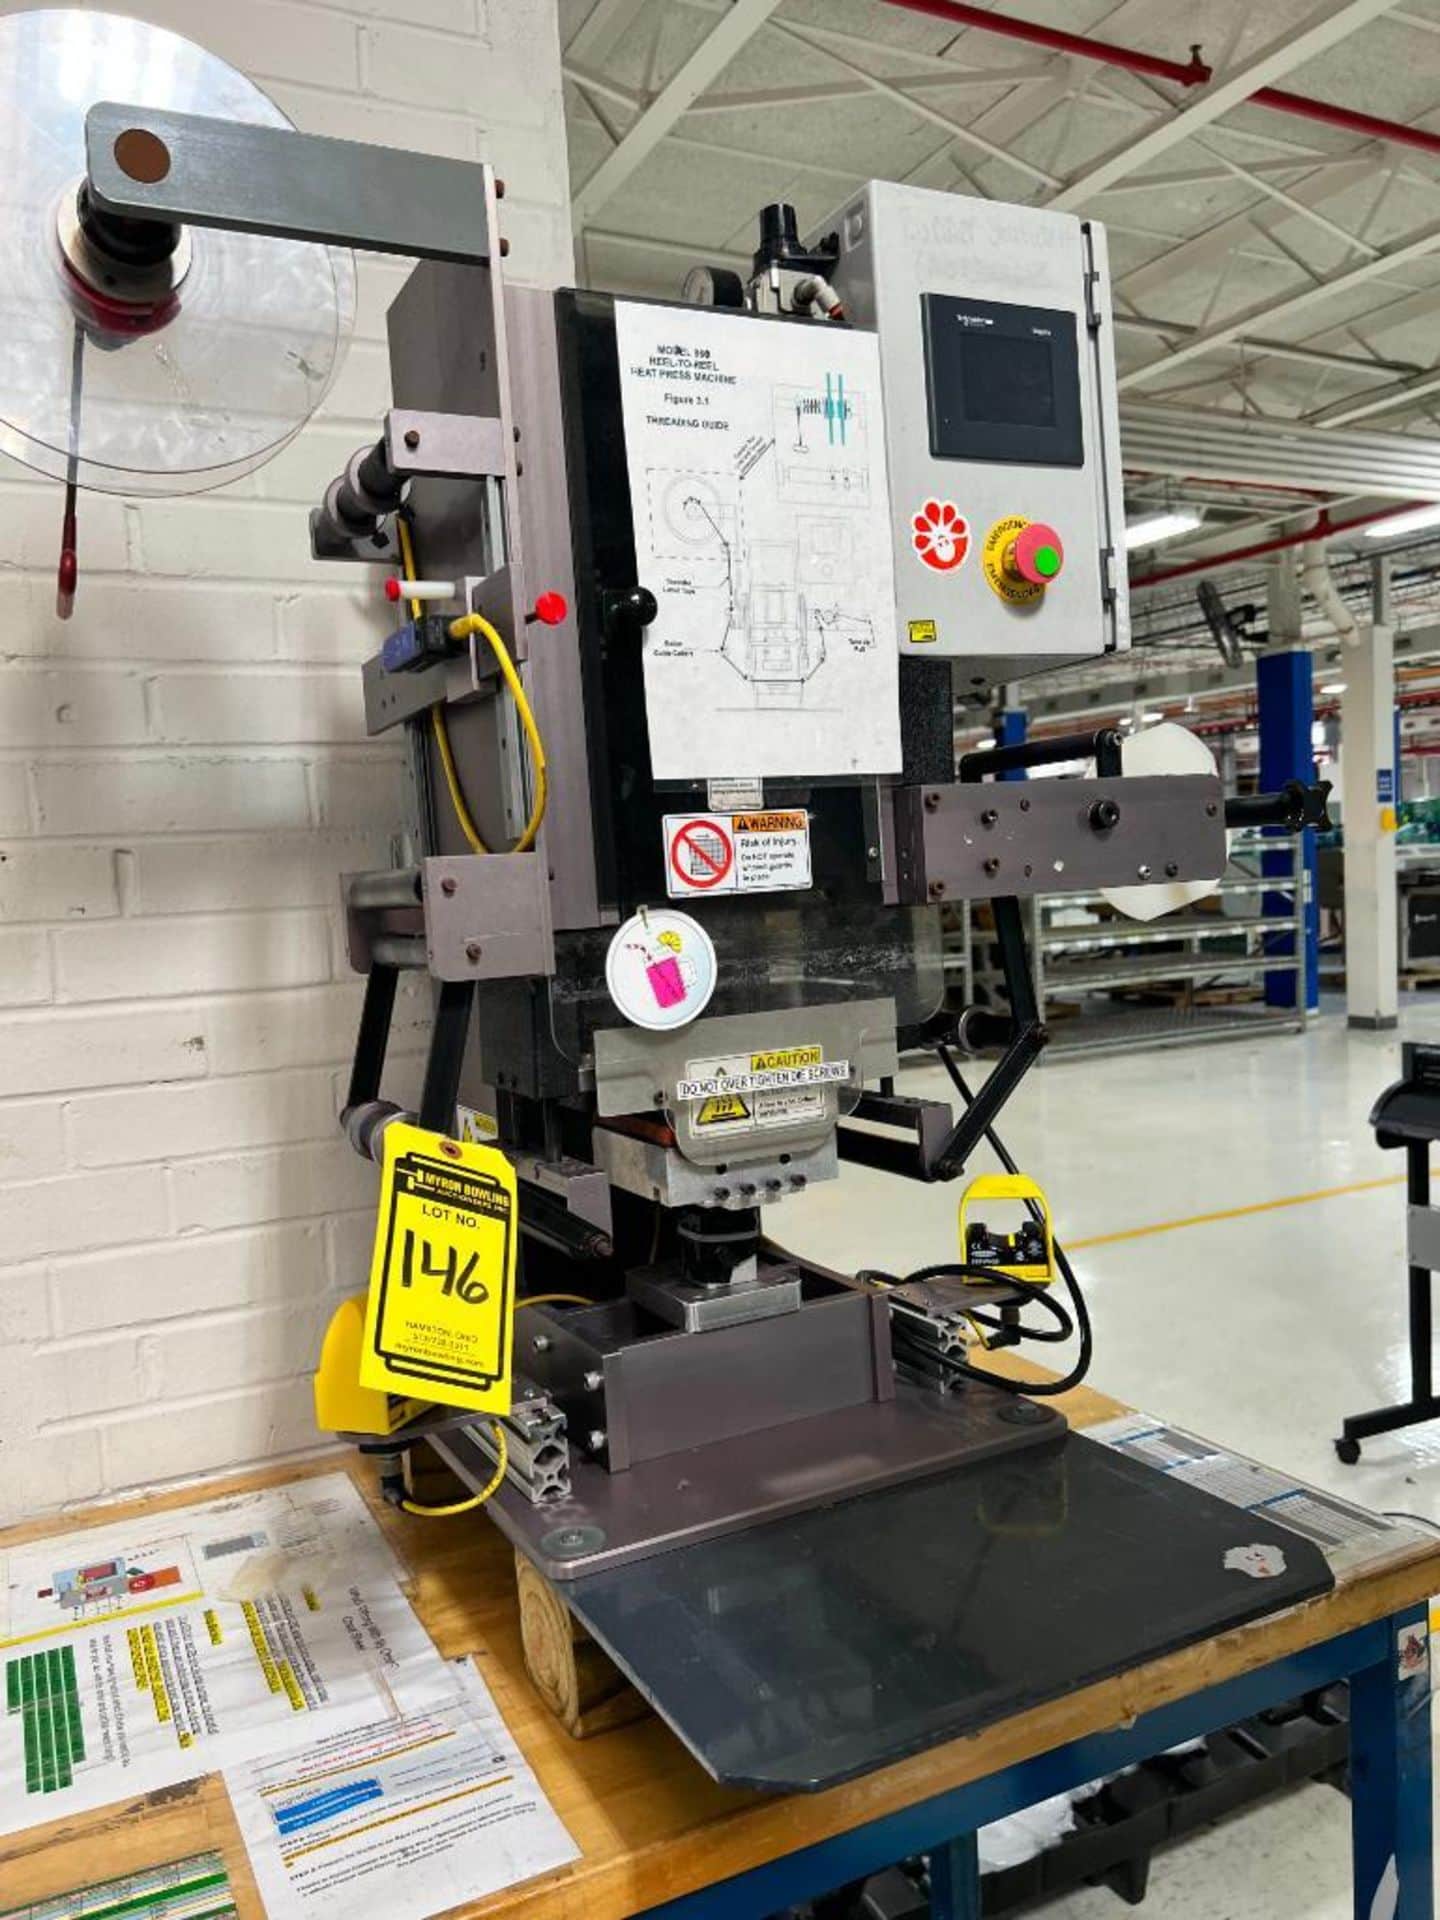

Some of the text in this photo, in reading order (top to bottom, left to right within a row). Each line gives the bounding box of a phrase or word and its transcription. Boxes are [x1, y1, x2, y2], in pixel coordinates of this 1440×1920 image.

[631, 367, 737, 385] HEAT PRESS MACHINE
[664, 392, 694, 405] Figure
[646, 415, 700, 428] THREADING
[749, 815, 803, 829] WARNING
[741, 838, 760, 848] Risk
[762, 838, 771, 846] of
[767, 1050, 818, 1068] CAUTION
[683, 1083, 698, 1095] DO
[700, 1080, 719, 1093] NOT
[720, 1076, 747, 1090] OVER
[808, 1063, 846, 1080] SCREWS
[424, 1172, 510, 1207] MYRON BOWLING
[423, 1204, 481, 1230] LOT NO.
[401, 1228, 490, 1305] 146
